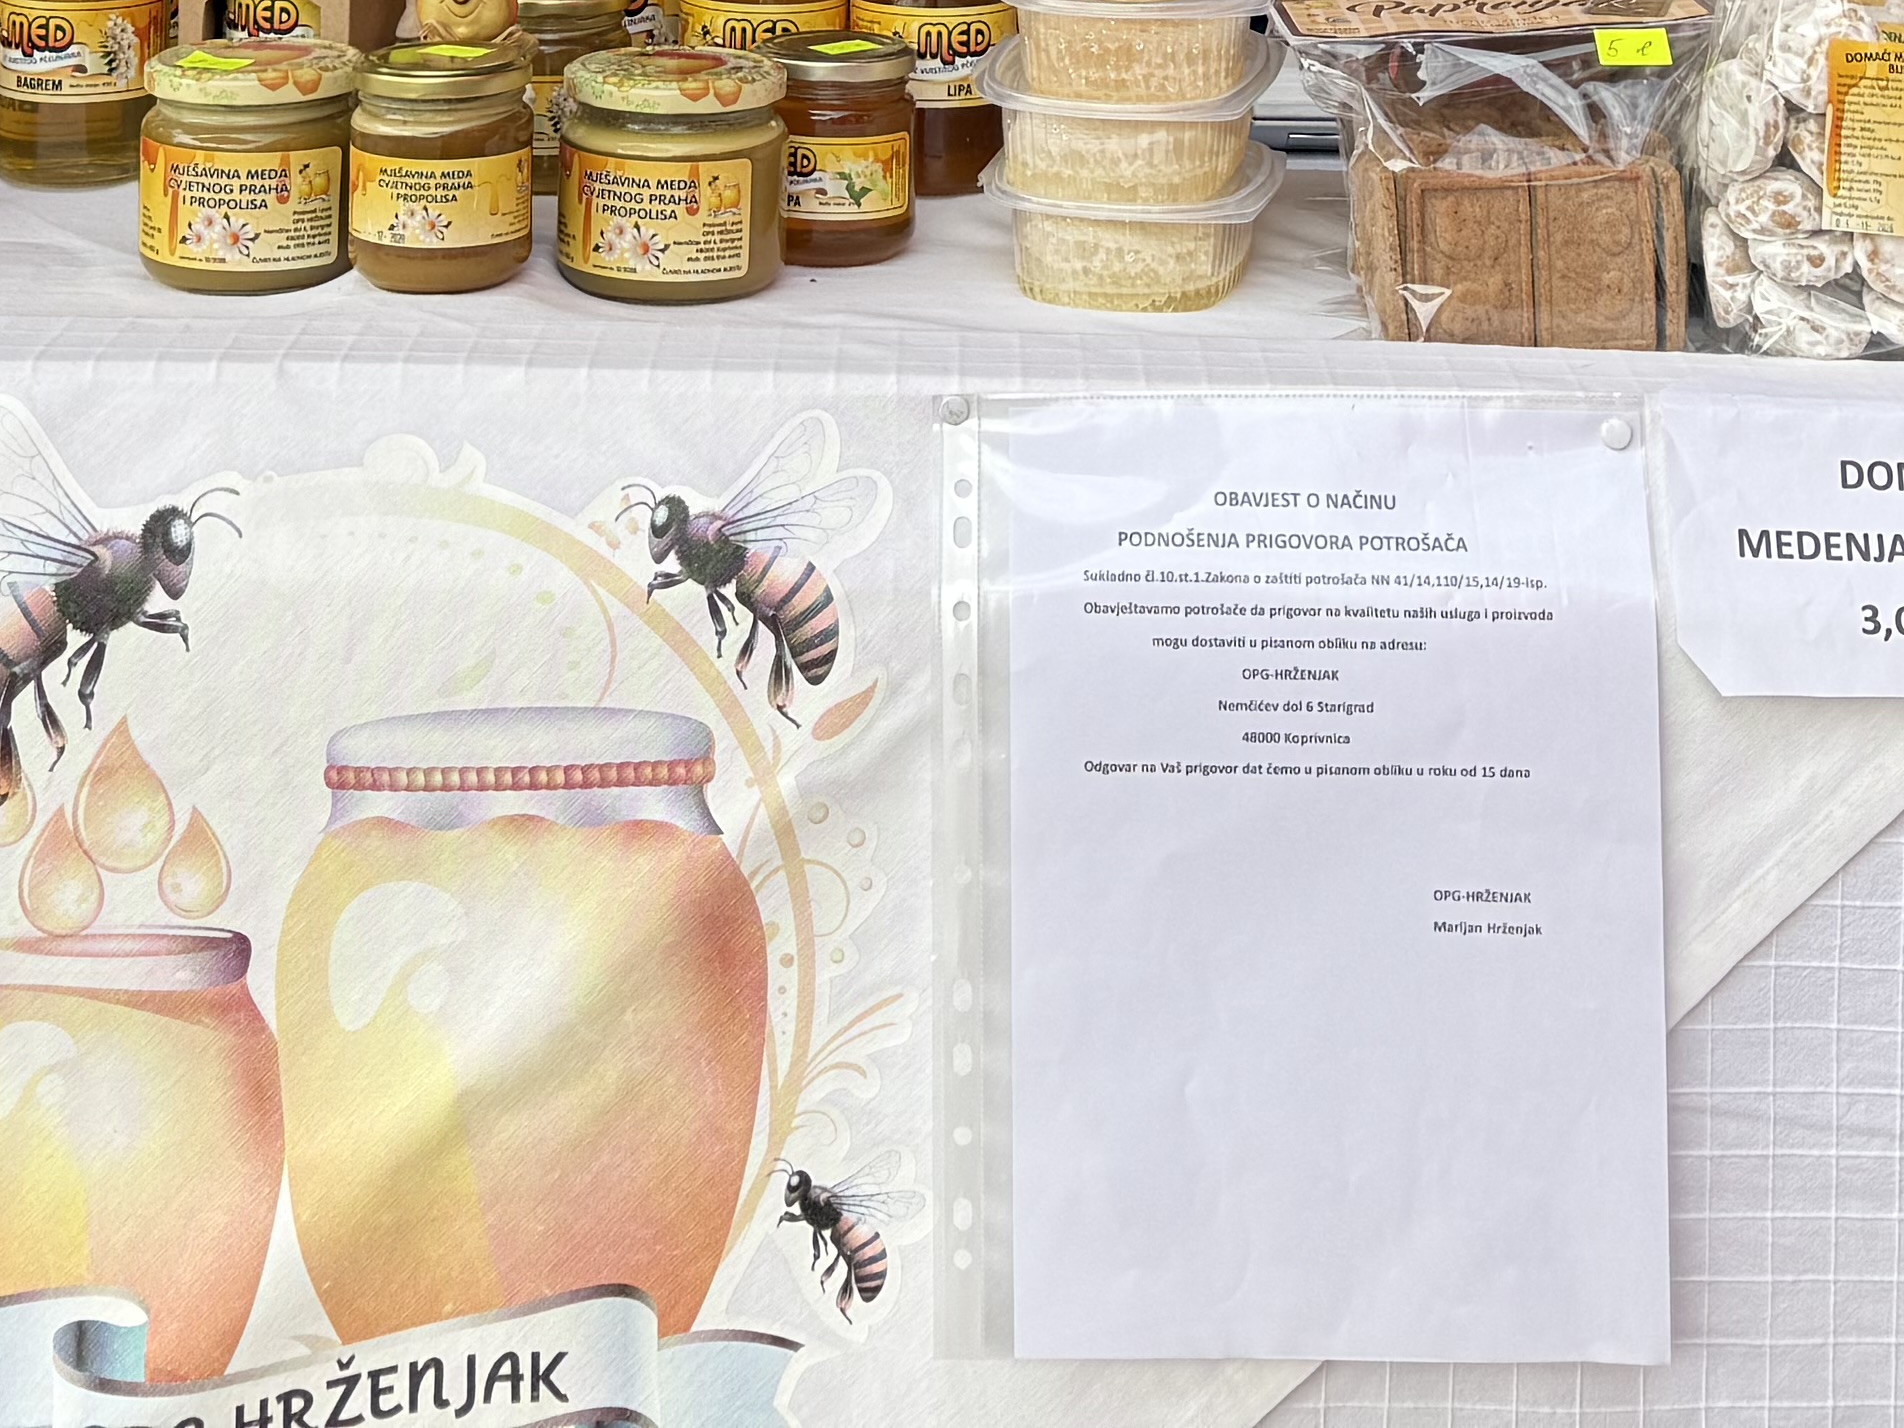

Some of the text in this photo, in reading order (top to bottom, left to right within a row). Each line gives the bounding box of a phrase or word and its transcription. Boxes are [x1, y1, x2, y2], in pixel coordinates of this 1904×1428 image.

[7, 13, 75, 56] MED
[917, 19, 991, 65] MED
[1845, 47, 1892, 65] DOMAĆI
[15, 75, 63, 92] BAGREM
[947, 83, 973, 98] LIPA
[583, 169, 699, 191] MJEŠAVINA MEDA
[582, 185, 700, 207] CVJETNOG PRAHA
[602, 204, 679, 221] PROPOLISA
[1213, 488, 1397, 512] OBAVJEST O NAČINU
[1117, 526, 1469, 554] PODNOŠENJA PRIGOVORA POTROŠAČA
[1433, 888, 1532, 904] OPG-HRŽENJAK
[1433, 921, 1543, 938] Marijan Hrženjak
